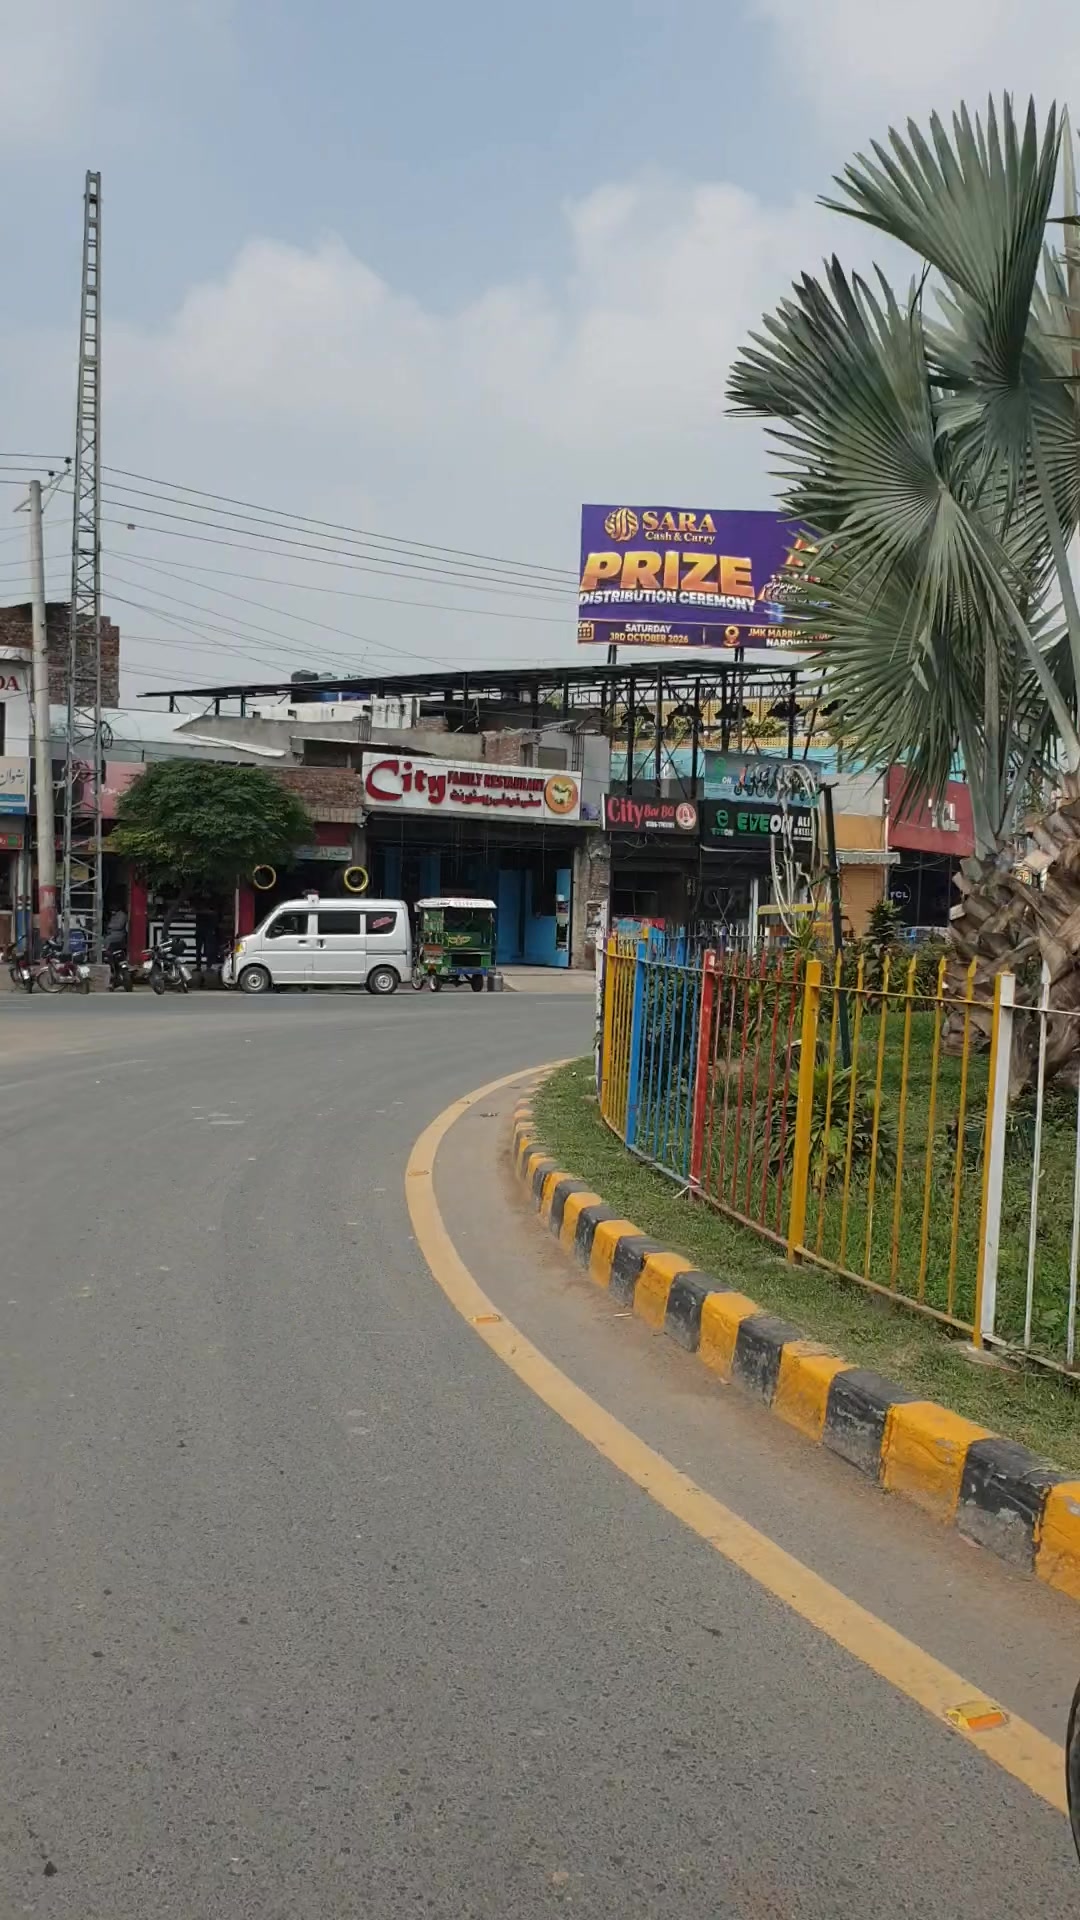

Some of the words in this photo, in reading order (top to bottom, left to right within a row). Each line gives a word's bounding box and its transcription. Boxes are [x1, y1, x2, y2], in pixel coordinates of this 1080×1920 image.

[642, 511, 717, 533] SARA
[645, 531, 672, 541] Cash
[674, 533, 682, 542] &
[684, 533, 716, 545] Carry
[580, 551, 755, 597] PRIZE
[579, 589, 677, 606] DISTRIBUTION
[679, 591, 756, 612] CEREMONY
[625, 623, 672, 633] SATURDAY
[748, 628, 766, 637] JMK
[609, 632, 626, 641] 3RD
[627, 632, 667, 643] OCTOBER
[668, 634, 689, 643] 2026
[366, 760, 446, 804] City
[448, 771, 483, 786] FAMILY
[484, 773, 546, 792] RESTAURANT
[607, 797, 643, 828] City
[798, 815, 810, 827] ALI
